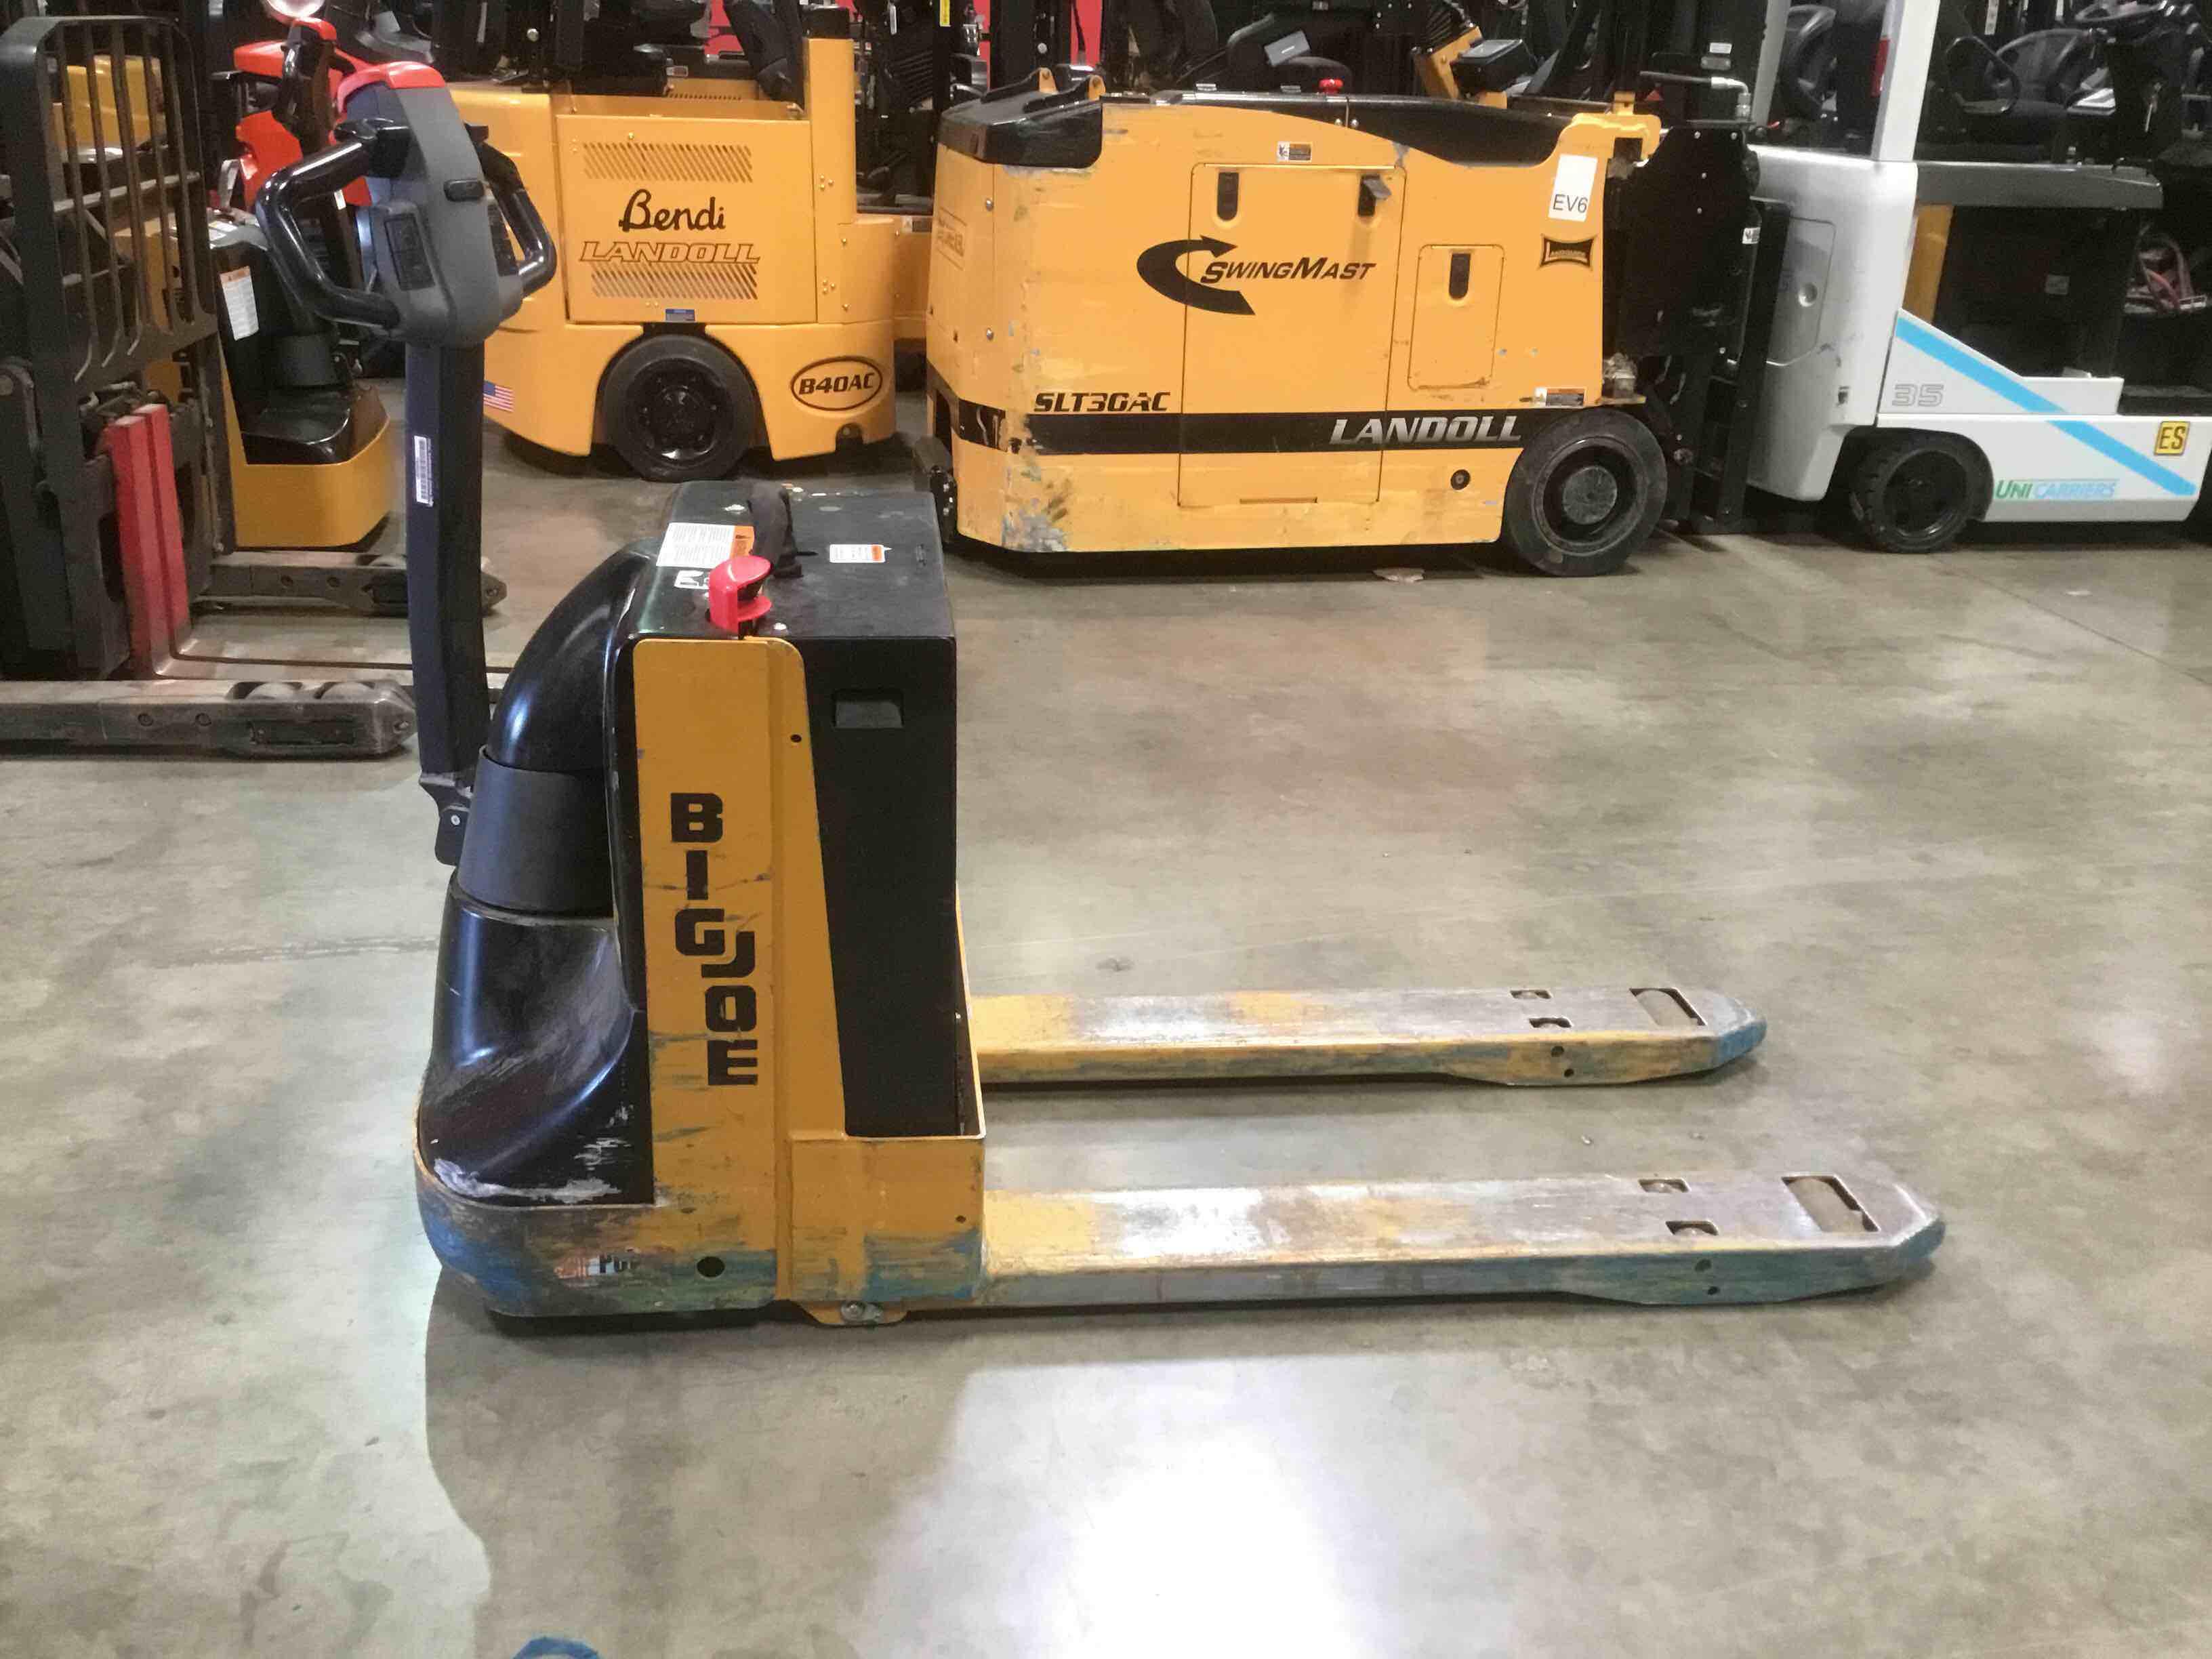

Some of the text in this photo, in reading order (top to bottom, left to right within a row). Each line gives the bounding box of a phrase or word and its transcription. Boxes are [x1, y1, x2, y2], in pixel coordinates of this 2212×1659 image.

[619, 189, 725, 232] Bendi
[1553, 194, 1588, 213] EV6
[579, 241, 760, 264] LANDOLL
[799, 372, 874, 394] B40AC
[1033, 392, 1170, 412] SLT30AC
[1892, 384, 1945, 407] 35
[1329, 415, 1521, 445] LANDOLL
[2158, 426, 2186, 449] ES
